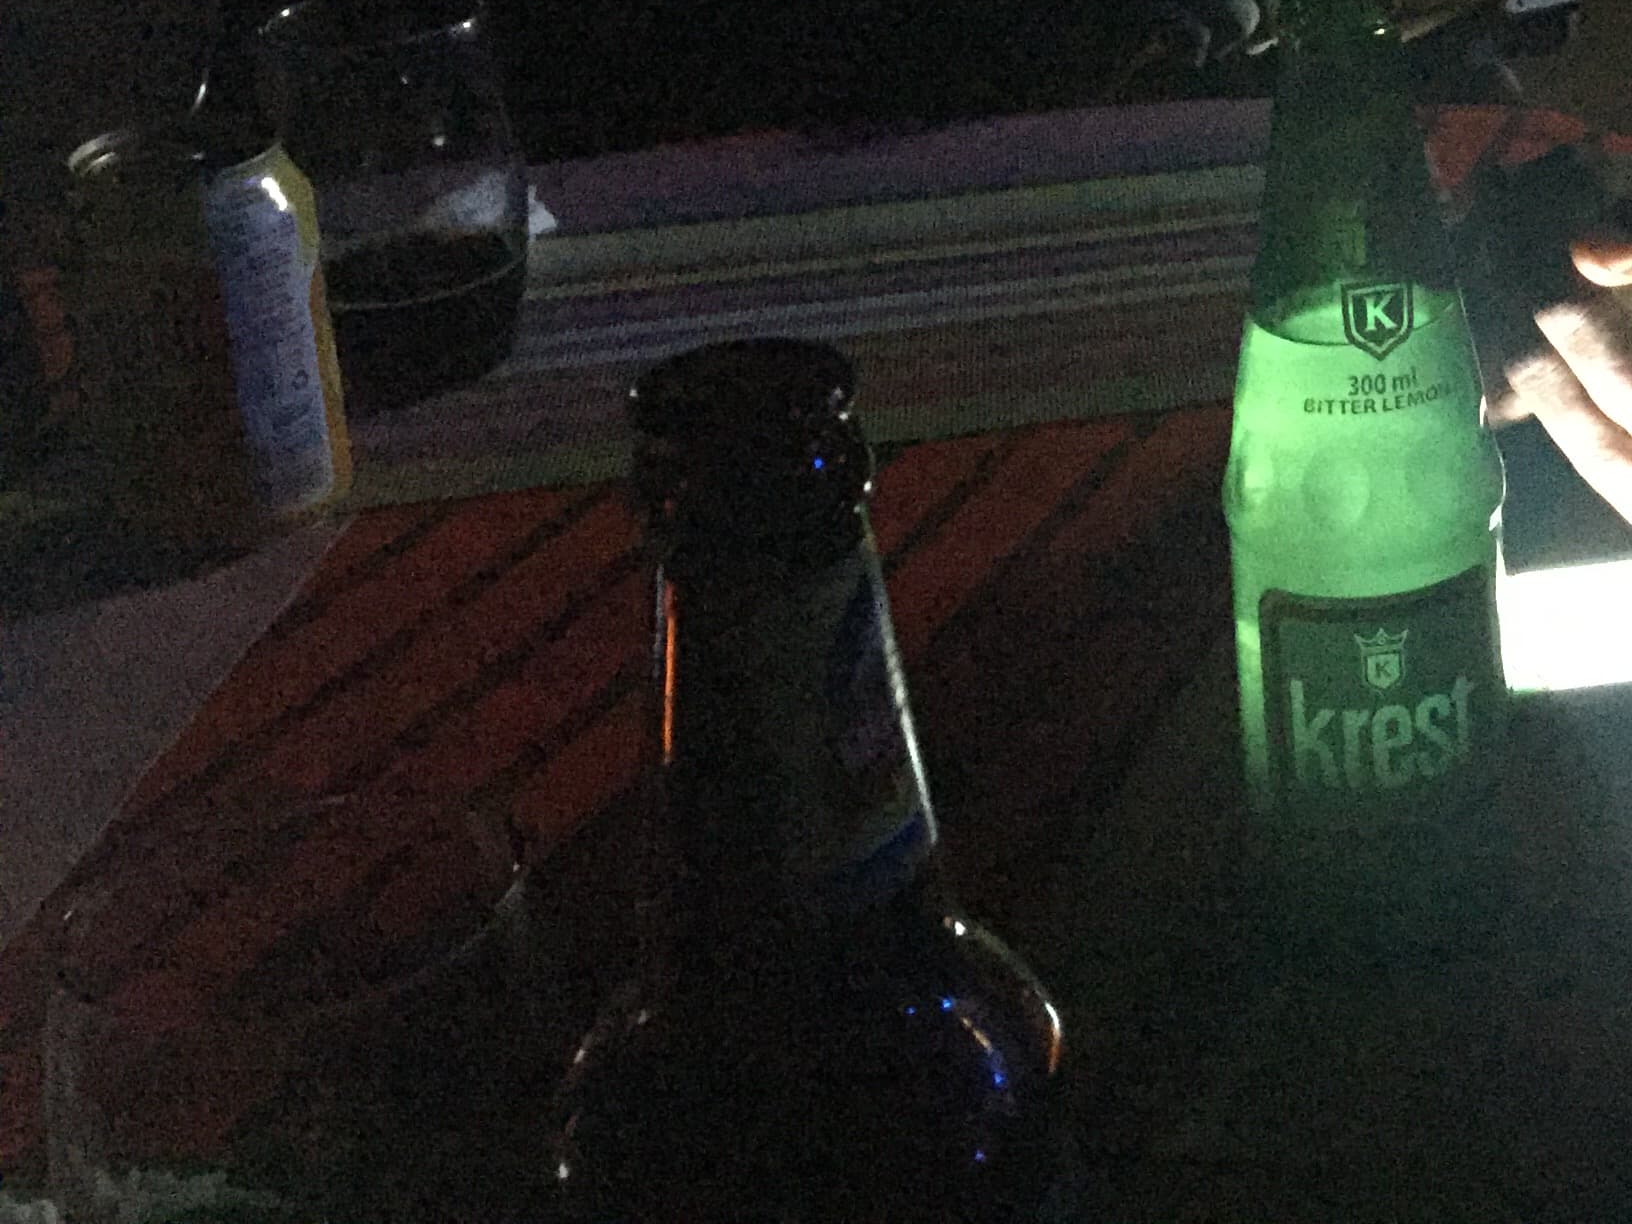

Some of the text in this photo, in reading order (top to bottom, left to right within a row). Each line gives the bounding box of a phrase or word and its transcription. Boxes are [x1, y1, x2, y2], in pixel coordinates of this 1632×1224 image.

[1363, 292, 1399, 331] K
[1348, 366, 1418, 397] 300 ml
[1303, 396, 1377, 416] BITTER
[1289, 675, 1476, 789] krest
